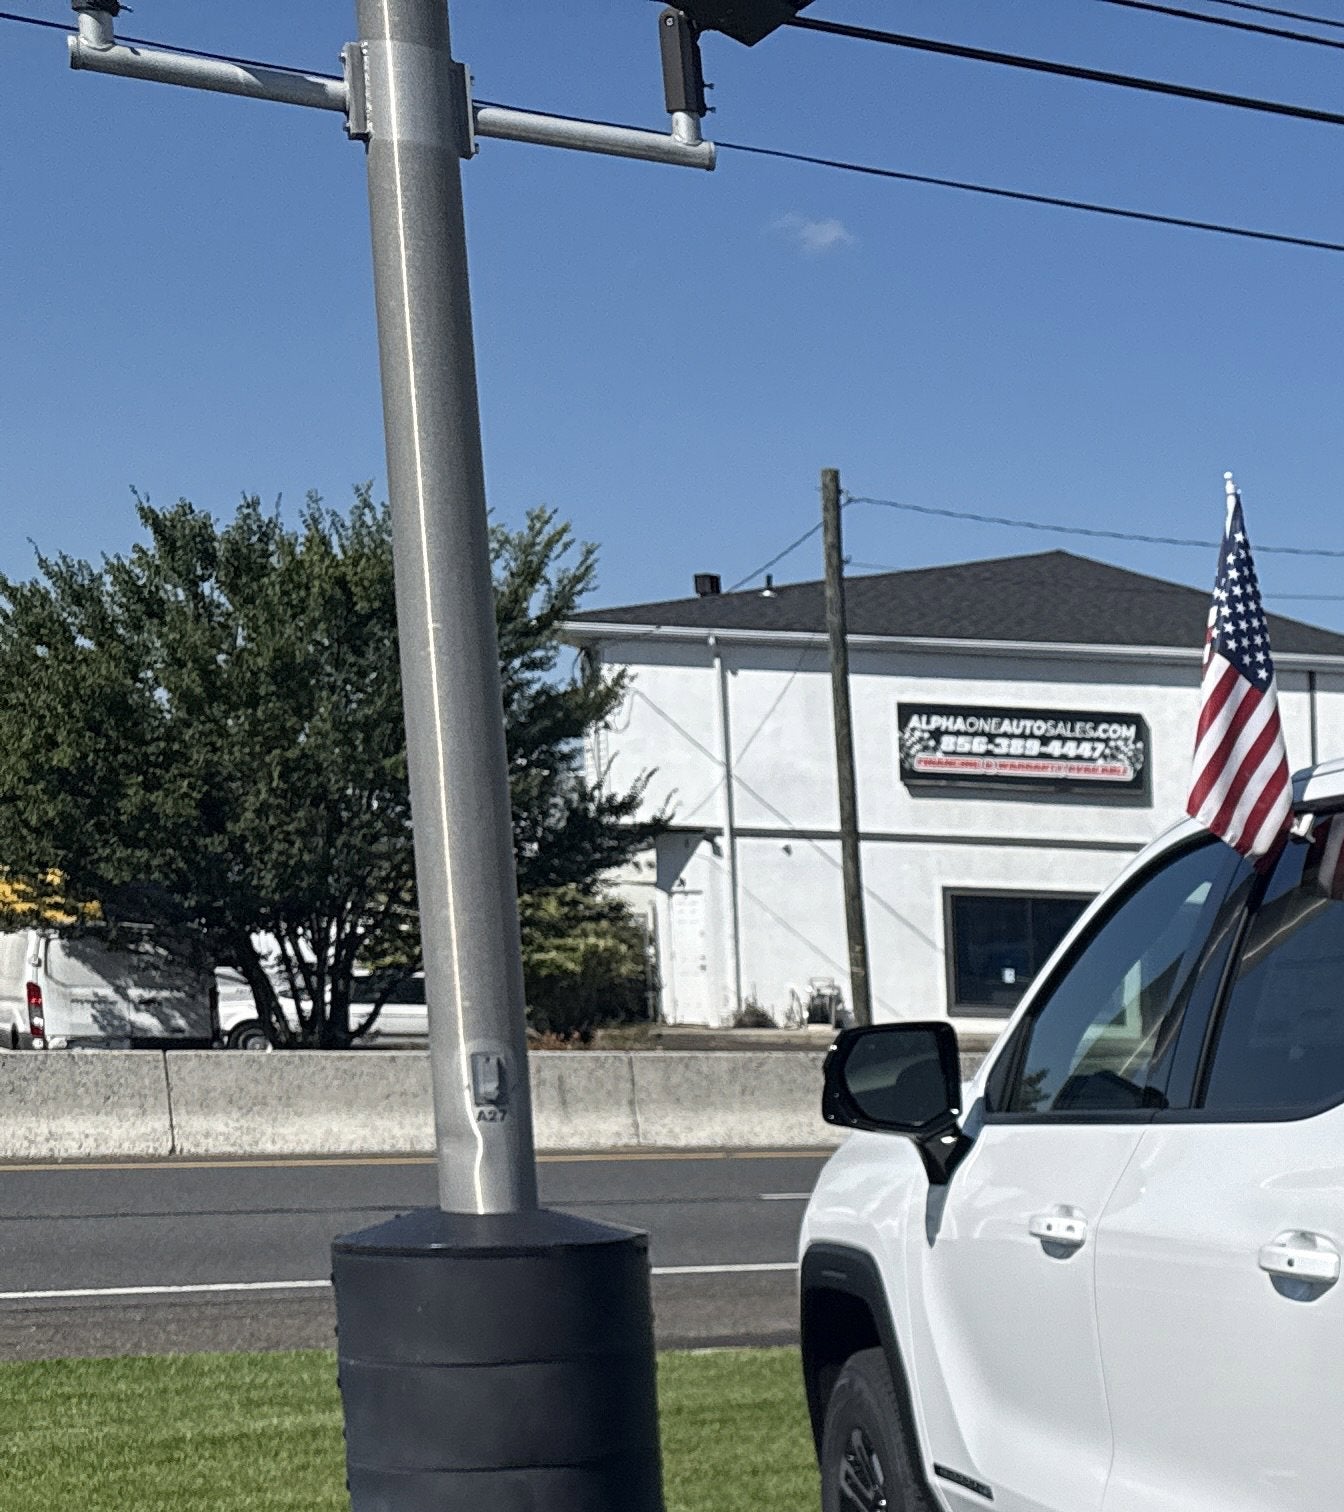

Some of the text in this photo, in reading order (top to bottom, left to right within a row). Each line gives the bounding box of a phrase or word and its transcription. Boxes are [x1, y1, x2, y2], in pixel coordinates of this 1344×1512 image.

[908, 714, 1136, 740] ALPHAONEAUTOSALES.COM
[940, 735, 1106, 759] 856-389-4447
[477, 1109, 507, 1122] A27
